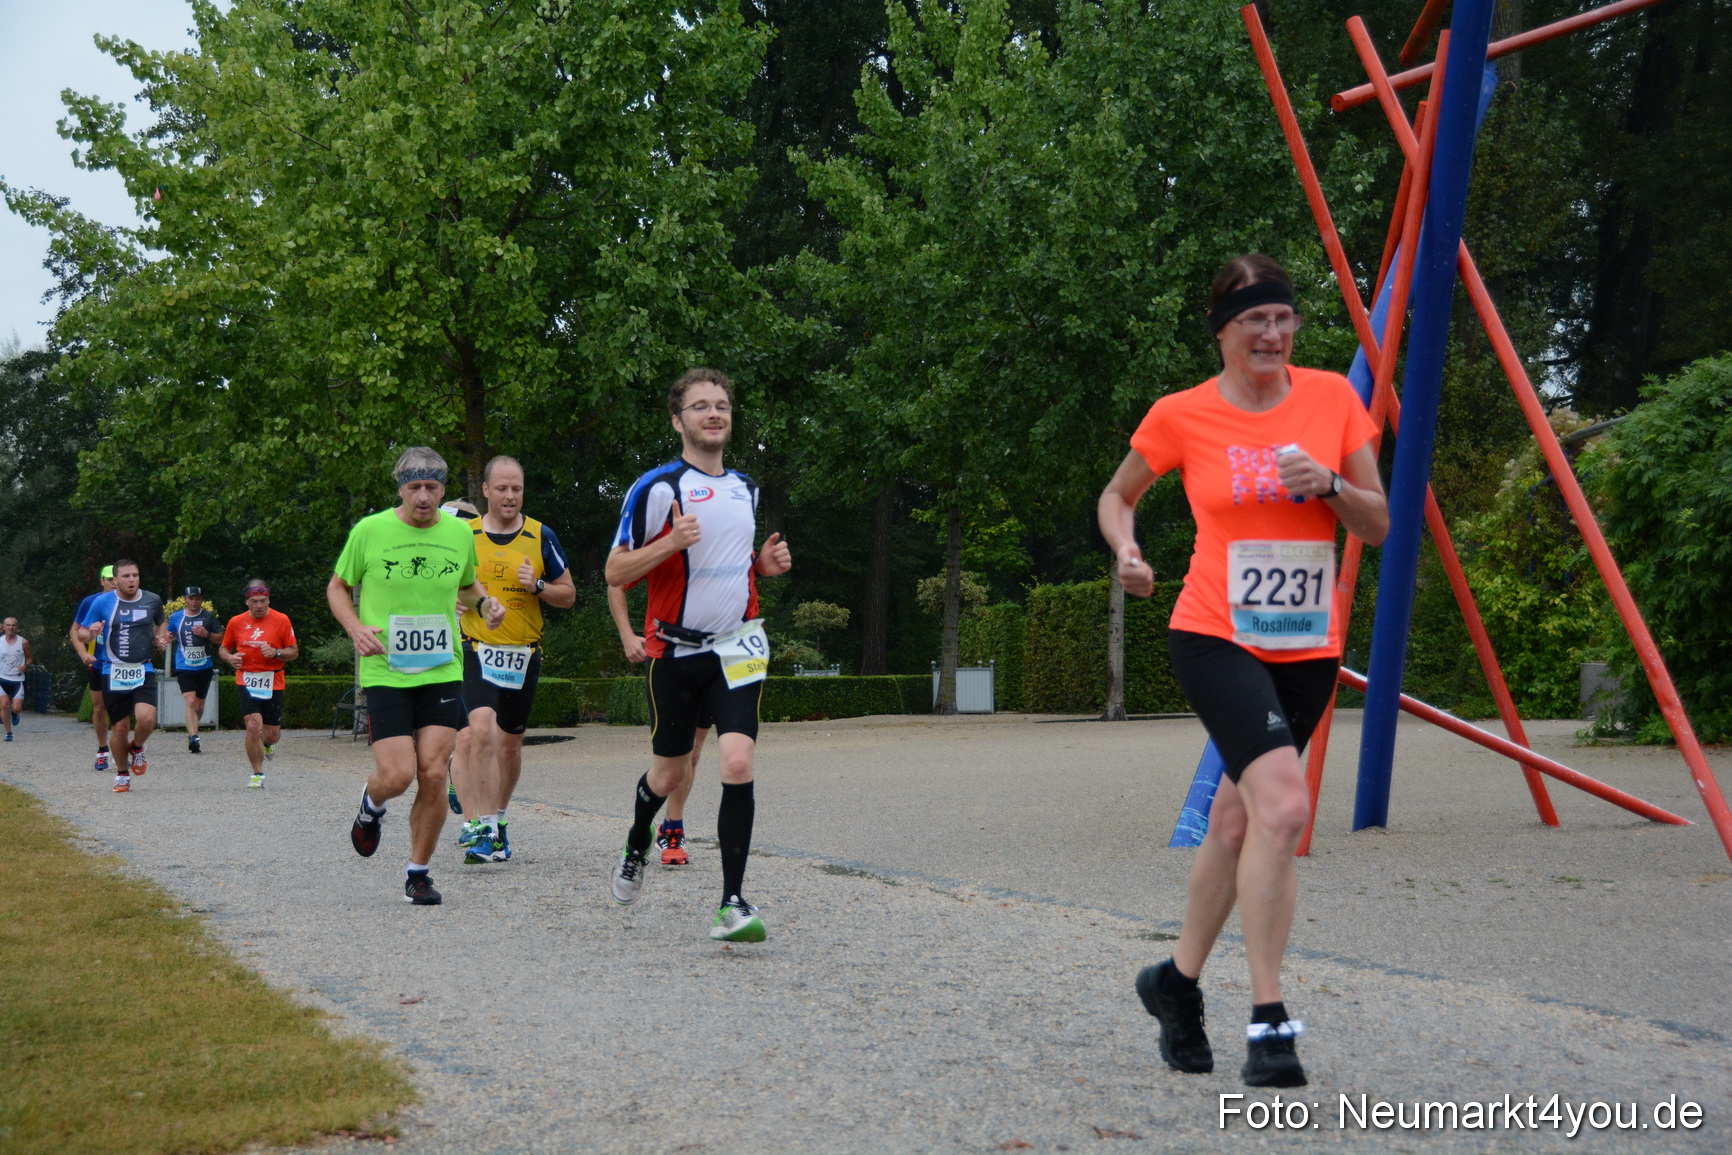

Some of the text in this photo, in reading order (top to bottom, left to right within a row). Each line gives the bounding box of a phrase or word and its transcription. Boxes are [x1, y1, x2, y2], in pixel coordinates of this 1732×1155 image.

[689, 488, 708, 497] tkn
[1232, 474, 1292, 504] FA
[1241, 567, 1324, 606] 2231
[119, 609, 131, 657] HIMATEC
[1252, 615, 1313, 633] Rosalinde
[395, 629, 448, 652] 3054
[187, 650, 206, 660] 2639
[483, 648, 526, 670] 2815
[114, 668, 142, 680] 2098
[245, 676, 271, 689] 2614
